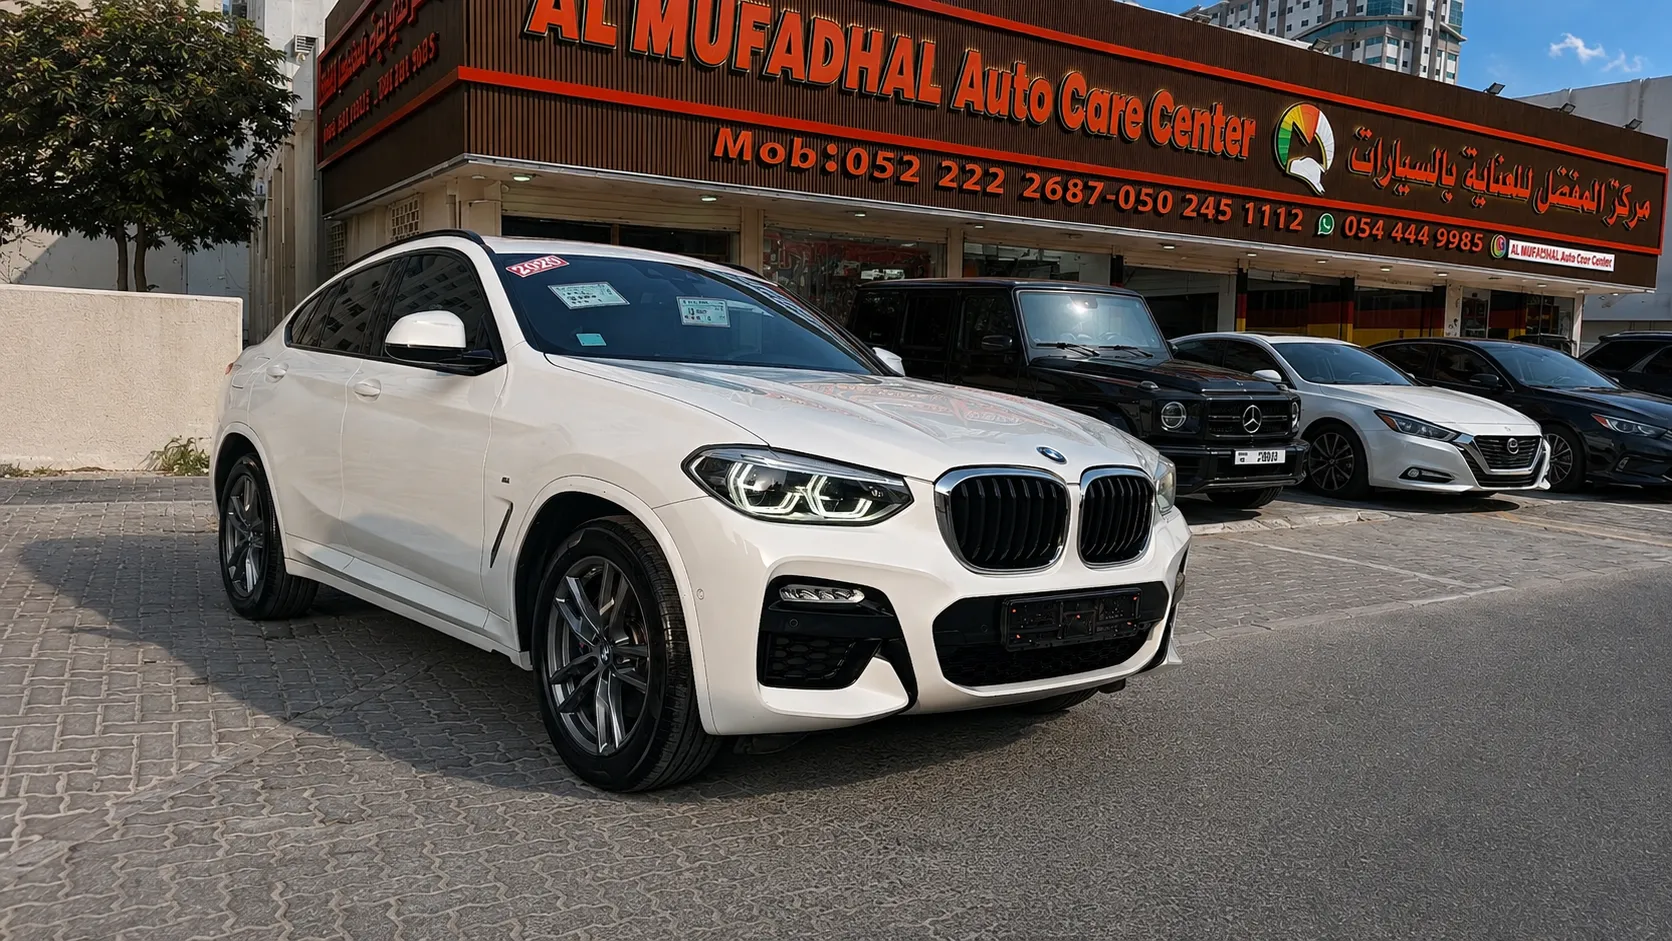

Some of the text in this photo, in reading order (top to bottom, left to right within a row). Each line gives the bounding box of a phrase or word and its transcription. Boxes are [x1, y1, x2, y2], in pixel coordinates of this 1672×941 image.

[630, 0, 942, 108] MUFADHAL
[951, 48, 1052, 125] Auto
[1059, 71, 1145, 141] Care
[1149, 89, 1256, 160] Center
[938, 161, 1006, 195] 222
[1183, 193, 1233, 222] 245
[1244, 202, 1304, 231] 1112
[1348, 126, 1651, 230] مركز المفضل للعناية بالسيارات
[511, 255, 563, 275] 2020
[1344, 215, 1484, 253] 054 444 9985
